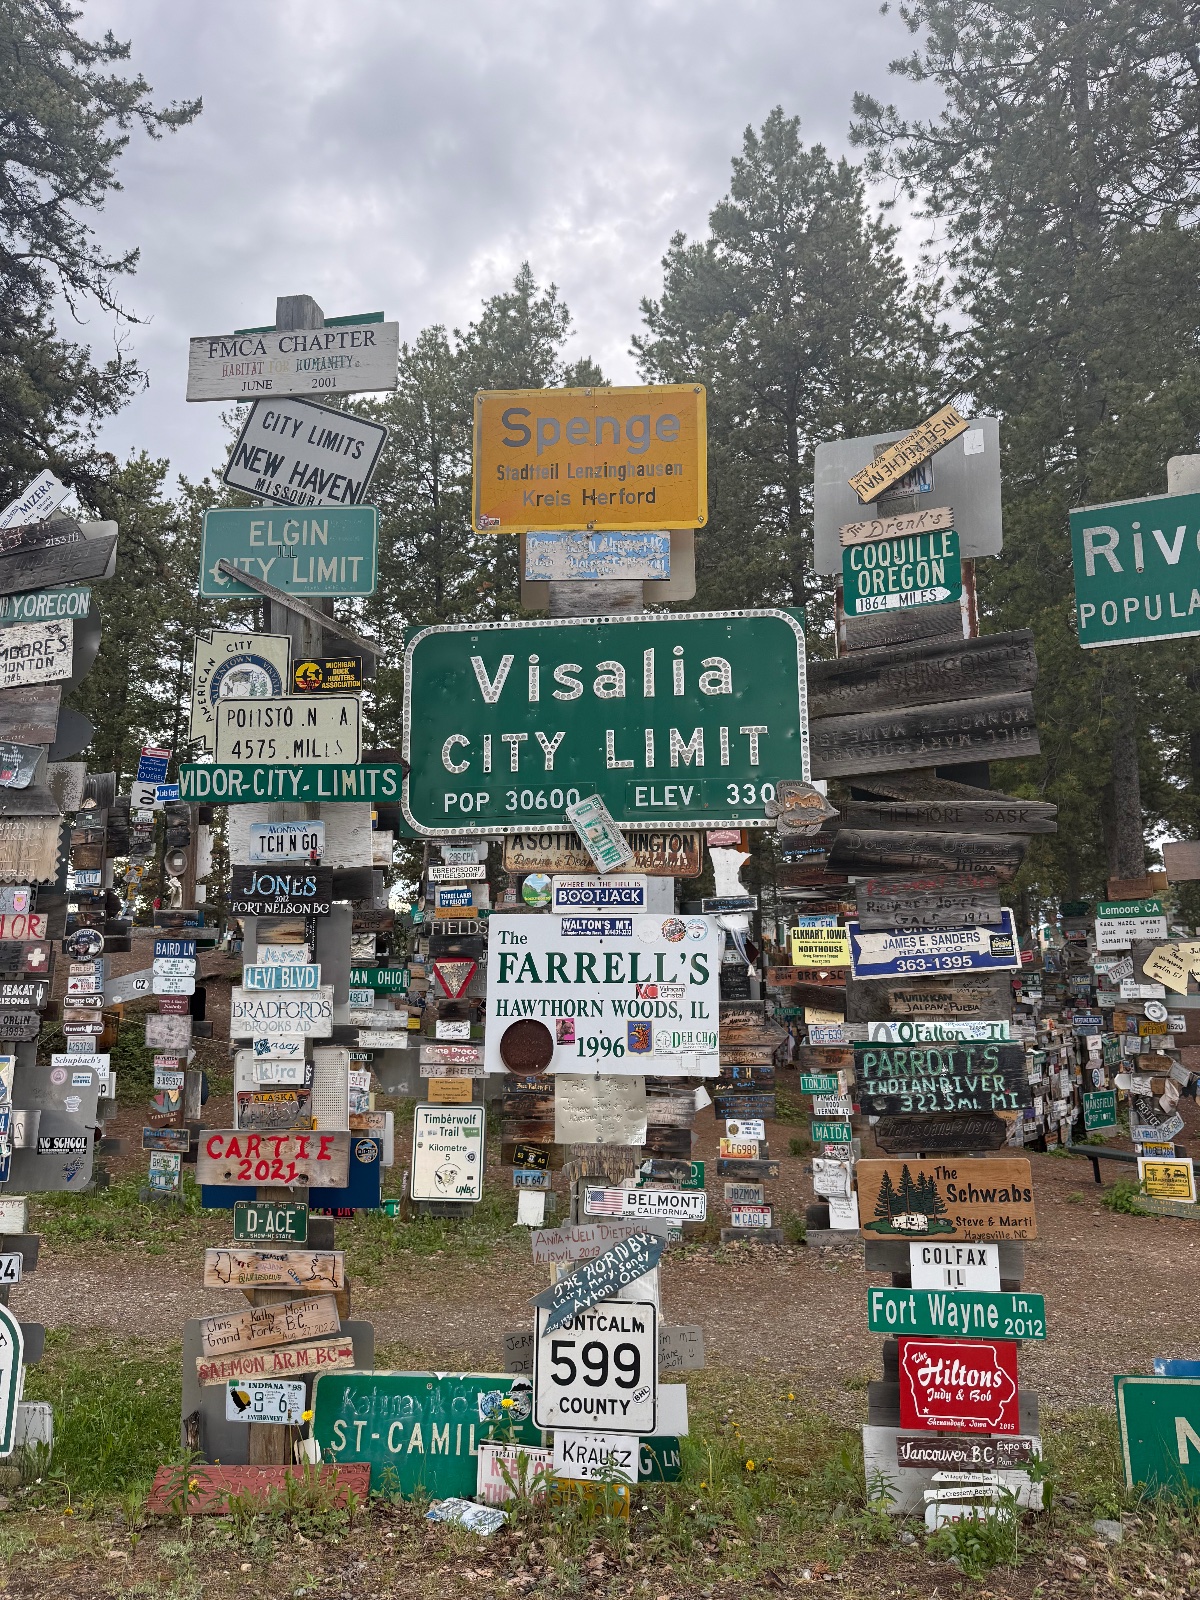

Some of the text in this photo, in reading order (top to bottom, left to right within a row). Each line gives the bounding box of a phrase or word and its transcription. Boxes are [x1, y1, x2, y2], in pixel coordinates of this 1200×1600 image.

[208, 330, 376, 358] FMCA CHAPTER
[222, 355, 352, 378] HABITAT HUMANITY
[241, 377, 337, 391] JUNE 2001
[262, 411, 365, 460] CITY LIMITS
[501, 407, 680, 456] Spenge
[235, 443, 362, 505] NEW HAVEN
[497, 461, 683, 481] Stadtteil Lenzinghausen
[20, 480, 54, 515] MIZERA
[523, 487, 656, 506] Kreis Herford
[250, 520, 328, 546] ELGIN
[850, 531, 954, 571] COQUILLE
[1083, 521, 1200, 577] Riv
[209, 557, 363, 585] CITY LIMIT
[858, 559, 945, 596] OREGON
[859, 589, 937, 611] 1864 MILES
[227, 641, 252, 653] CITY
[211, 655, 252, 699] ALLENTOWN
[469, 645, 733, 704] Visalia
[198, 657, 216, 723] AMERICAN
[322, 681, 361, 689] ASSOCIATION
[232, 739, 276, 759] 4575
[441, 725, 768, 774] CITY LIMIT
[444, 792, 490, 813] POP
[635, 785, 694, 807] ELEV
[879, 808, 1029, 823] FILLMORE SASK
[268, 826, 307, 834] MONTANA
[259, 833, 318, 852] TCH N GO
[244, 871, 317, 897] JONES
[558, 889, 640, 904] BOOTJACK
[232, 902, 330, 915] FORT NELSON BC
[1099, 904, 1159, 915] Lemoore CA
[430, 920, 488, 935] FIELDS
[562, 919, 632, 930] WALTON'S MT.
[498, 931, 528, 945] The
[793, 929, 847, 940] ELKHART, IOWA
[882, 932, 981, 950] JAMES E. SANDERS
[156, 943, 194, 955] BAIRD LN
[496, 951, 710, 985] FARRELL'S
[896, 956, 973, 972] 363-1395
[135, 979, 147, 990] CZ
[281, 966, 315, 988] BLVD
[378, 972, 402, 984] OHIO
[232, 1000, 331, 1022] BRADFORDS
[496, 999, 710, 1022] HAWTHORN WOODS, IL
[244, 1021, 311, 1032] BROOKS AB
[577, 1036, 625, 1058] 1996
[54, 1057, 101, 1065] Schupbach's
[864, 1046, 999, 1077] PARROTTS
[254, 1093, 295, 1102] ALASKA
[424, 1113, 477, 1125] Timberwolf
[439, 1126, 459, 1137] Trail
[39, 1138, 87, 1149] NO SCHOOL
[206, 1134, 335, 1160] CARTIE
[429, 1143, 467, 1152] Kilometre
[727, 1144, 757, 1155] LFG989
[445, 1153, 451, 1161] 5
[238, 1159, 300, 1183] 2021
[934, 1166, 957, 1180] The
[456, 1184, 477, 1196] UNBC
[946, 1183, 1032, 1203] Schwabs
[627, 1194, 700, 1208] BELMONT
[637, 1208, 688, 1216] CALIFORNIA
[742, 1213, 768, 1224] CAGLE
[247, 1210, 296, 1234] D-ACE
[956, 1216, 1032, 1227] Steve & Marti
[1014, 1230, 1028, 1239] NC
[580, 1246, 600, 1258] 2013
[923, 1248, 986, 1265] COLFAX
[619, 1251, 648, 1272] Sandy
[619, 1264, 649, 1284] Ont.
[947, 1270, 964, 1286] IL
[554, 1274, 582, 1297] THE
[872, 1292, 1033, 1334] Fort Wayne In.
[206, 1319, 232, 1333] Chris
[314, 1321, 335, 1333] 2022
[549, 1313, 645, 1333] ONTCALM
[1005, 1318, 1043, 1336] 2012
[207, 1328, 241, 1347] Grand
[199, 1348, 337, 1379] SALMON ARM BC
[551, 1340, 641, 1389] 599
[912, 1352, 928, 1364] The
[917, 1358, 1002, 1388] Hiltons
[248, 1382, 284, 1390] INDIANA
[633, 1387, 650, 1402] BHL
[927, 1388, 992, 1402] Judy & Bob
[559, 1397, 631, 1415] COUNTY
[969, 1420, 987, 1428] Iowa
[563, 1440, 632, 1468] KRAUSZ
[901, 1441, 1020, 1463] Vancouver B.C. Expo
[997, 1457, 1012, 1466] Pam
